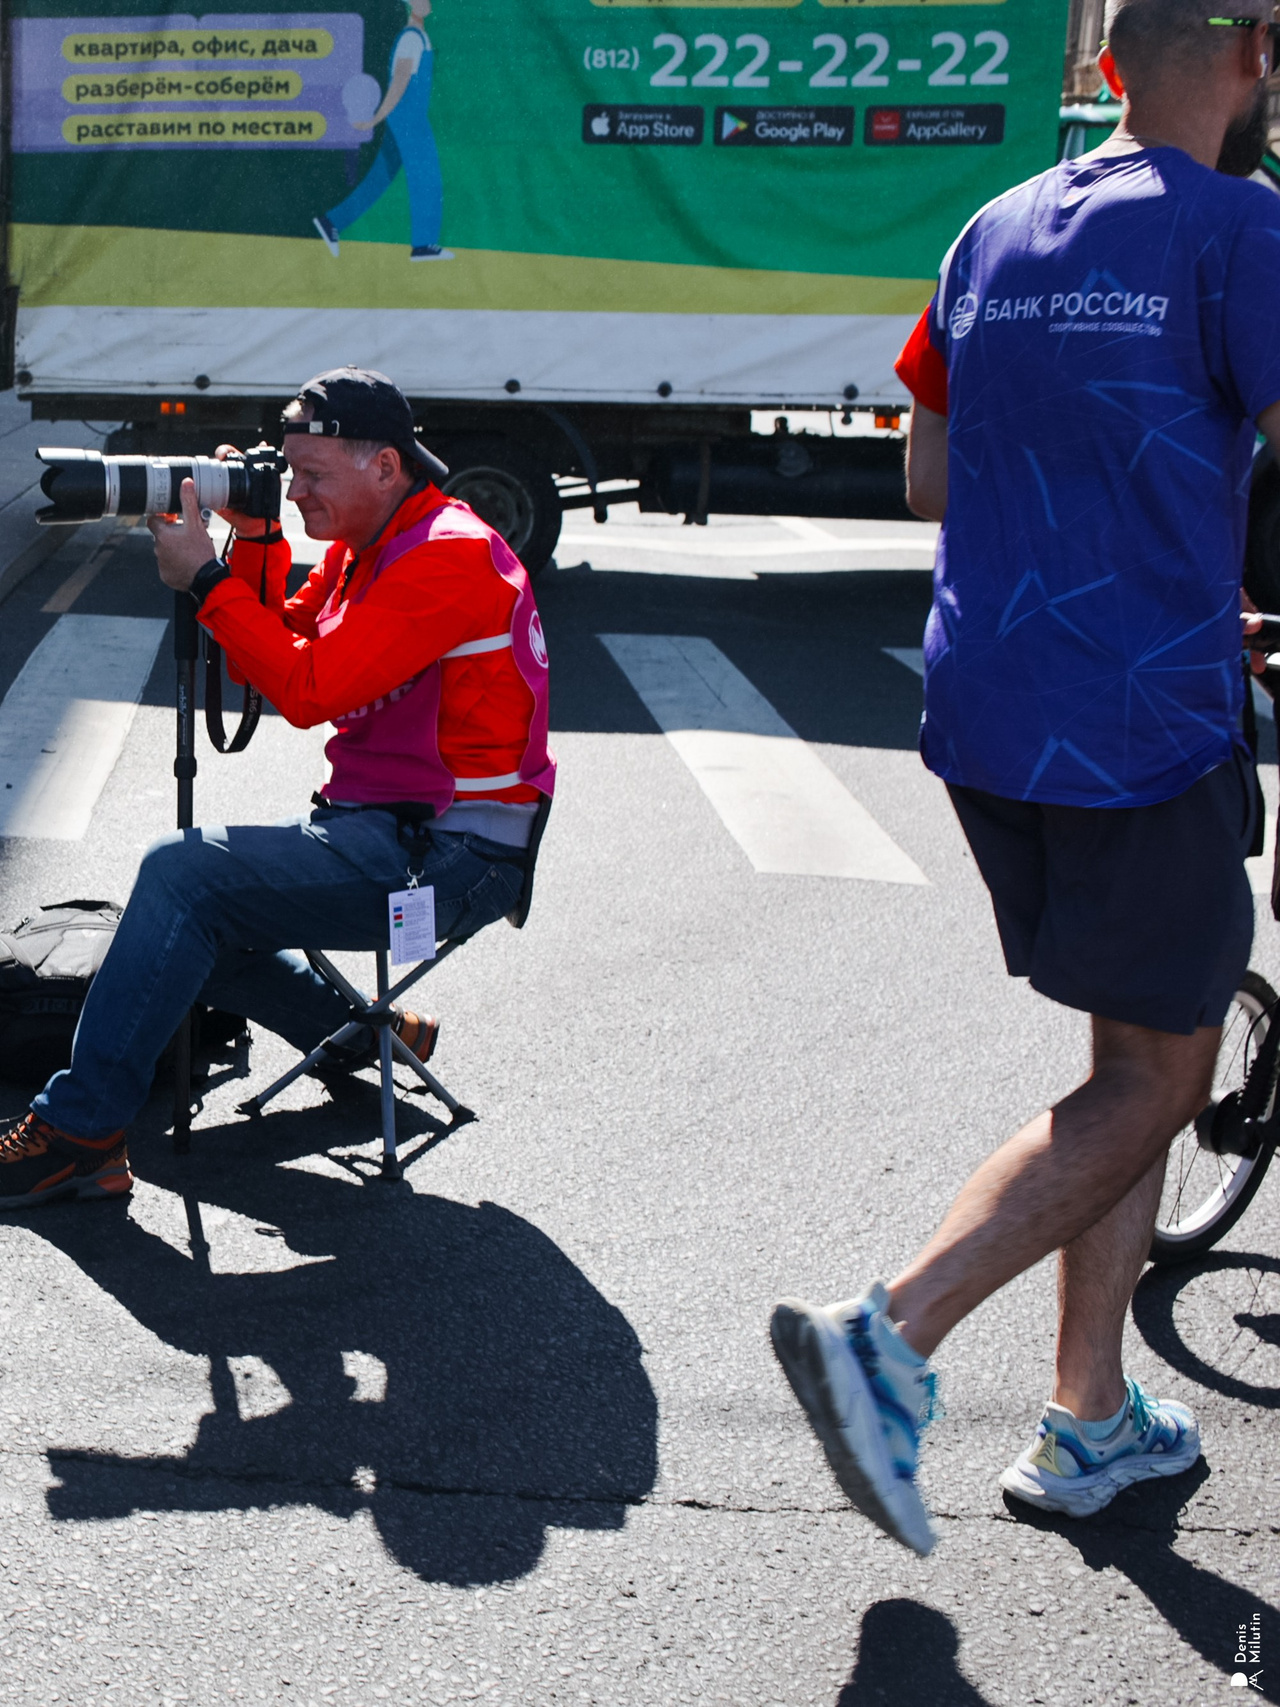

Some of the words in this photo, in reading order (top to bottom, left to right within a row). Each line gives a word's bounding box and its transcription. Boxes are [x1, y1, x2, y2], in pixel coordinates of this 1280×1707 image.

[73, 38, 185, 60] квартира,
[191, 36, 257, 58] офис,
[261, 37, 318, 57] дача
[583, 47, 640, 72] (812)
[650, 30, 1009, 87] 222-22-22
[75, 78, 290, 101] разберём-соберём
[76, 120, 192, 142] расставим
[198, 122, 225, 136] по
[231, 120, 313, 136] местам
[616, 121, 650, 139] App
[653, 121, 695, 137] Store
[755, 121, 811, 142] Google
[813, 121, 845, 142] Play
[906, 122, 987, 140] AppGallery
[984, 295, 1044, 322] БАНК
[1048, 291, 1169, 320] РОССИЯ
